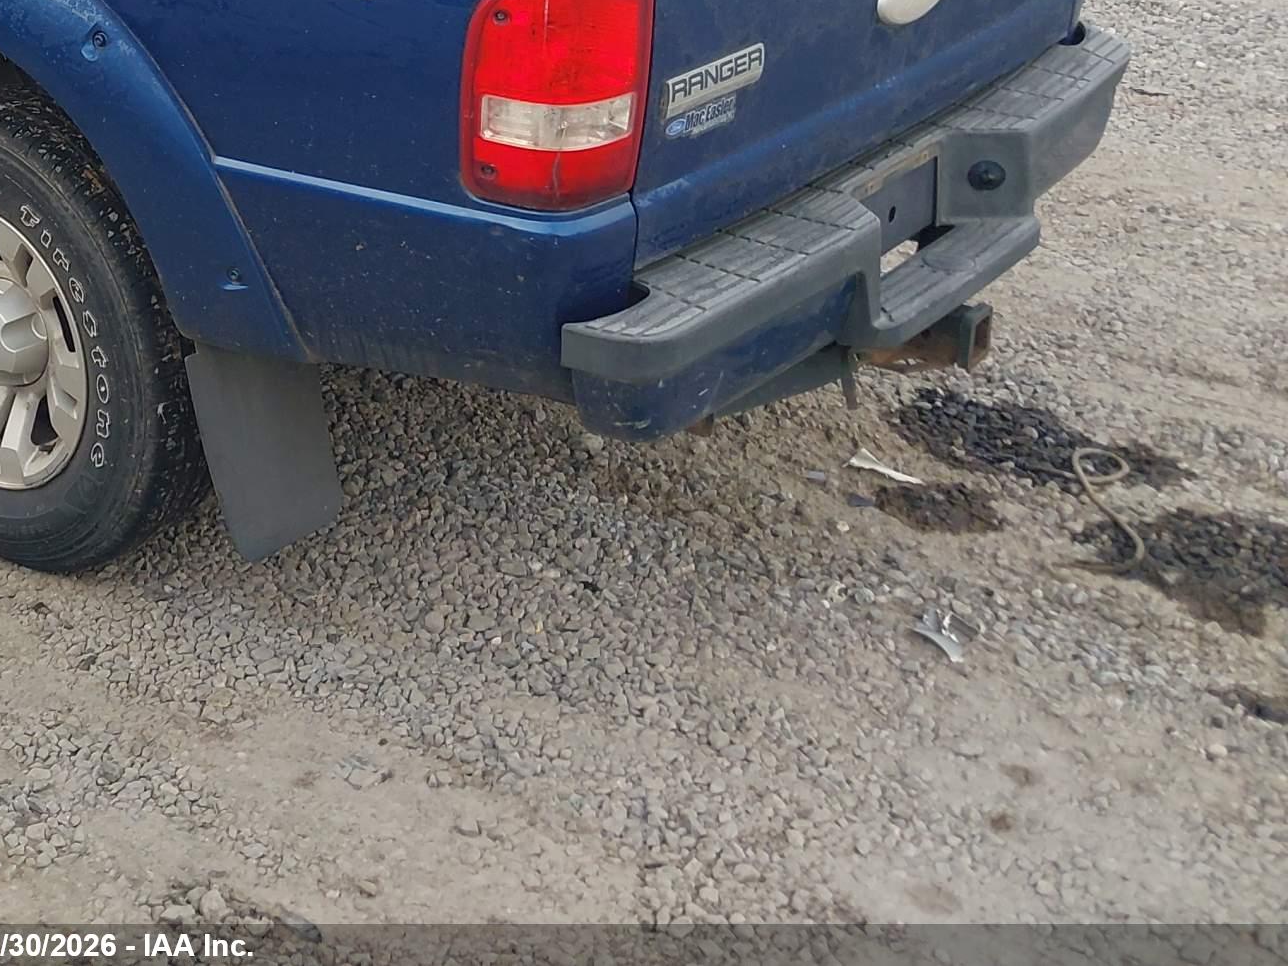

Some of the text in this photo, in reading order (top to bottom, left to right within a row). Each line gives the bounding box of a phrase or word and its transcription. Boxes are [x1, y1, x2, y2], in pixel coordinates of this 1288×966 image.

[671, 47, 763, 103] RANGER
[685, 109, 705, 131] Mac
[705, 97, 735, 122] Easler
[18, 204, 111, 469] Firestone
